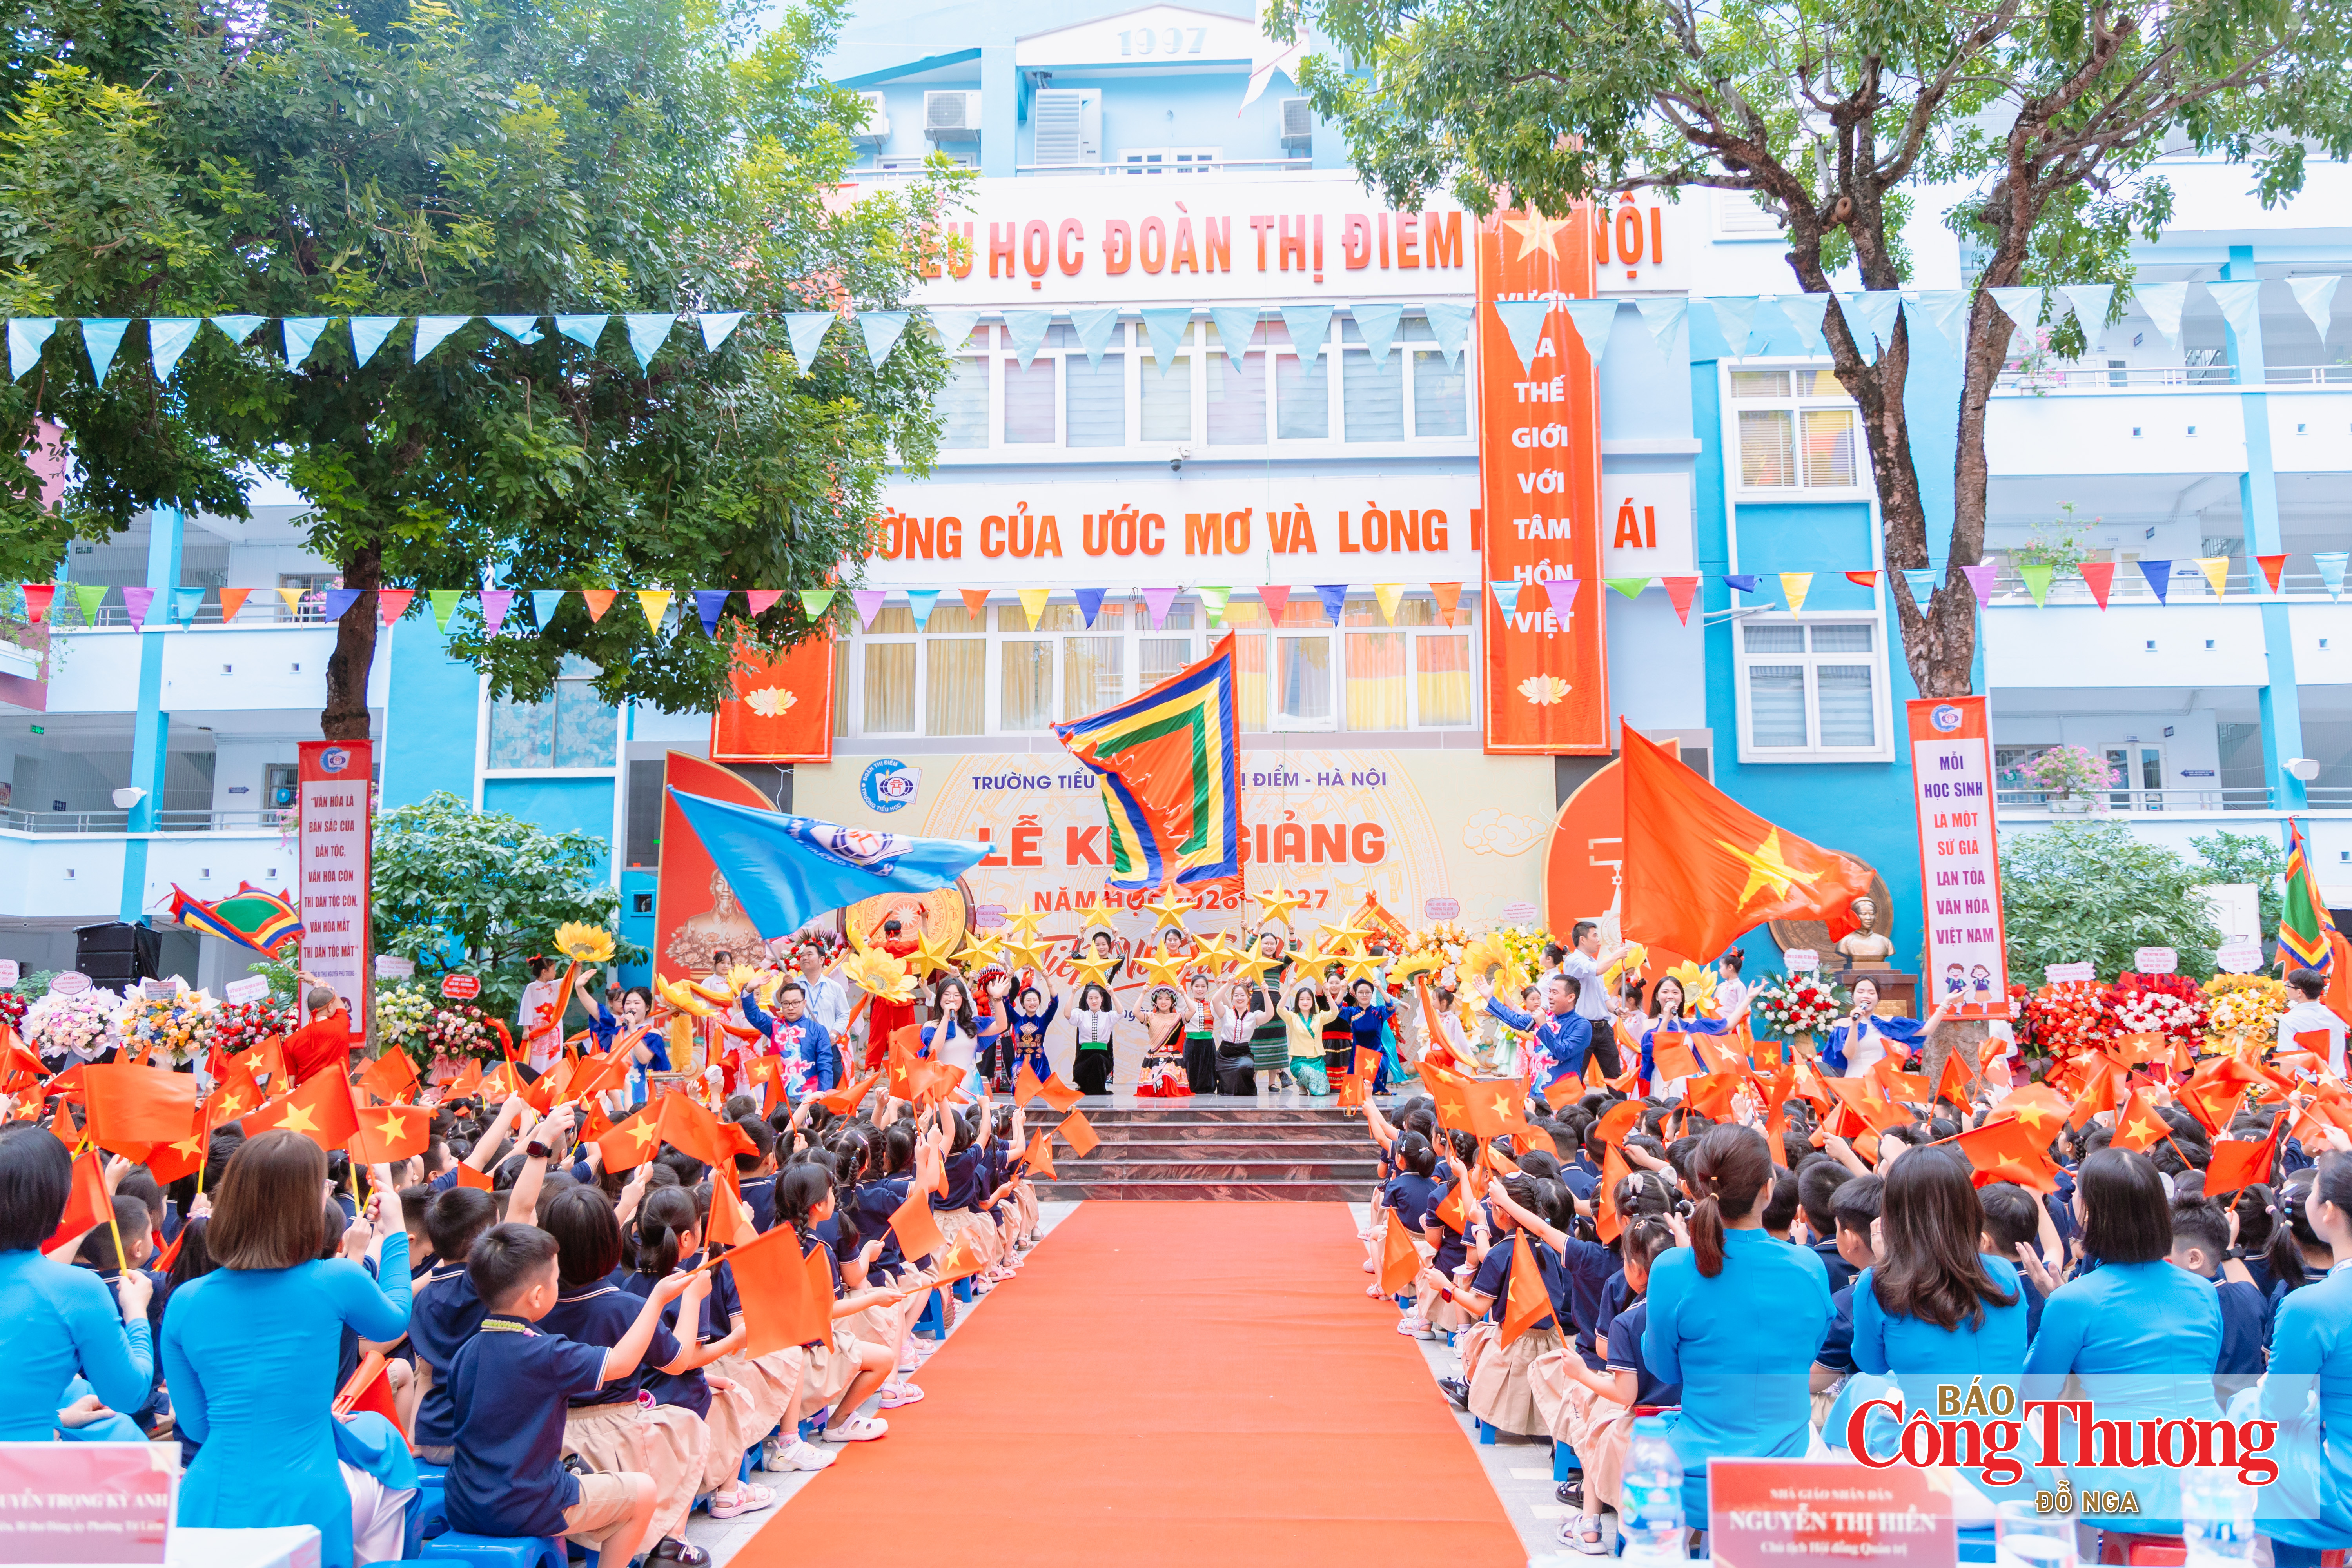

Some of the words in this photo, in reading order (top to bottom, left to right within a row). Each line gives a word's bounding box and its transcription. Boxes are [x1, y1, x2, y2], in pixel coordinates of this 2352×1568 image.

[1117, 27, 1209, 56] 1997
[989, 218, 1084, 289] HỌC
[1102, 201, 1231, 274] ĐOÀN
[1249, 214, 1324, 283] THỊ
[1513, 374, 1566, 403] THẾ
[1511, 422, 1568, 448] GIỚI
[1517, 468, 1564, 494] VỚI
[980, 501, 1063, 558] CỦA
[1083, 503, 1165, 556] ƯỚC
[1185, 507, 1252, 555] MƠ
[1266, 503, 1317, 554] VÀ
[1338, 501, 1448, 552] LÒNG
[1613, 497, 1657, 549] ÁI
[1513, 514, 1571, 540] TÂM
[1514, 558, 1573, 586] HỒN
[1514, 607, 1575, 639] VIỆT
[1939, 751, 1964, 771] MỖI
[972, 772, 1052, 790] TRƯỜNG
[1058, 767, 1095, 789] TIỂU
[1252, 764, 1299, 786] ĐIỂM
[1318, 768, 1345, 786] HÀ
[1352, 768, 1387, 790] NỘI
[330, 794, 343, 807] HÓA
[346, 794, 354, 807] LÀ
[1924, 783, 1949, 800] HỌC
[1954, 782, 1983, 797] SINH
[309, 818, 322, 833] BẢN
[325, 817, 338, 832] SẮC
[340, 818, 354, 832] CỦA
[1934, 811, 1948, 828] LÀ
[1952, 810, 1978, 830] MỘT
[978, 814, 1043, 866] LỄ
[1242, 810, 1386, 864] IẢNG
[1938, 838, 1955, 856] SỨ
[1959, 836, 1980, 855] GIẢ
[315, 844, 328, 858] DÂN
[331, 844, 346, 859] TỘC,
[308, 869, 321, 883] VĂN
[323, 869, 336, 882] HÓA
[338, 868, 354, 882] CÒN
[1936, 871, 1959, 886] LAN
[1962, 867, 1985, 885] TỎA
[304, 895, 313, 908] THÌ
[315, 895, 327, 907] DÂN
[328, 894, 340, 909] TỘC
[343, 894, 358, 908] CÒN,
[1034, 886, 1096, 911] NĂM
[1176, 890, 1238, 910] 26
[1936, 897, 1961, 915] VĂN
[1965, 896, 1990, 914] HÓA
[310, 919, 321, 933] VĂN
[323, 919, 336, 933] HÓA
[337, 916, 350, 932] MẤT
[1936, 927, 1963, 947] VIỆT
[1967, 927, 1994, 943] NAM
[303, 945, 313, 958] THÌ
[315, 944, 326, 958] DÂN
[328, 944, 339, 960] TỘC
[134, 1493, 168, 1508] ANH
[1770, 1486, 1796, 1500] NHÀ
[1797, 1486, 1830, 1501] GIÁO
[1729, 1502, 1828, 1532] NGUYỄN
[1830, 1511, 1873, 1537] THỊ
[1878, 1503, 1936, 1532] HIỀN
